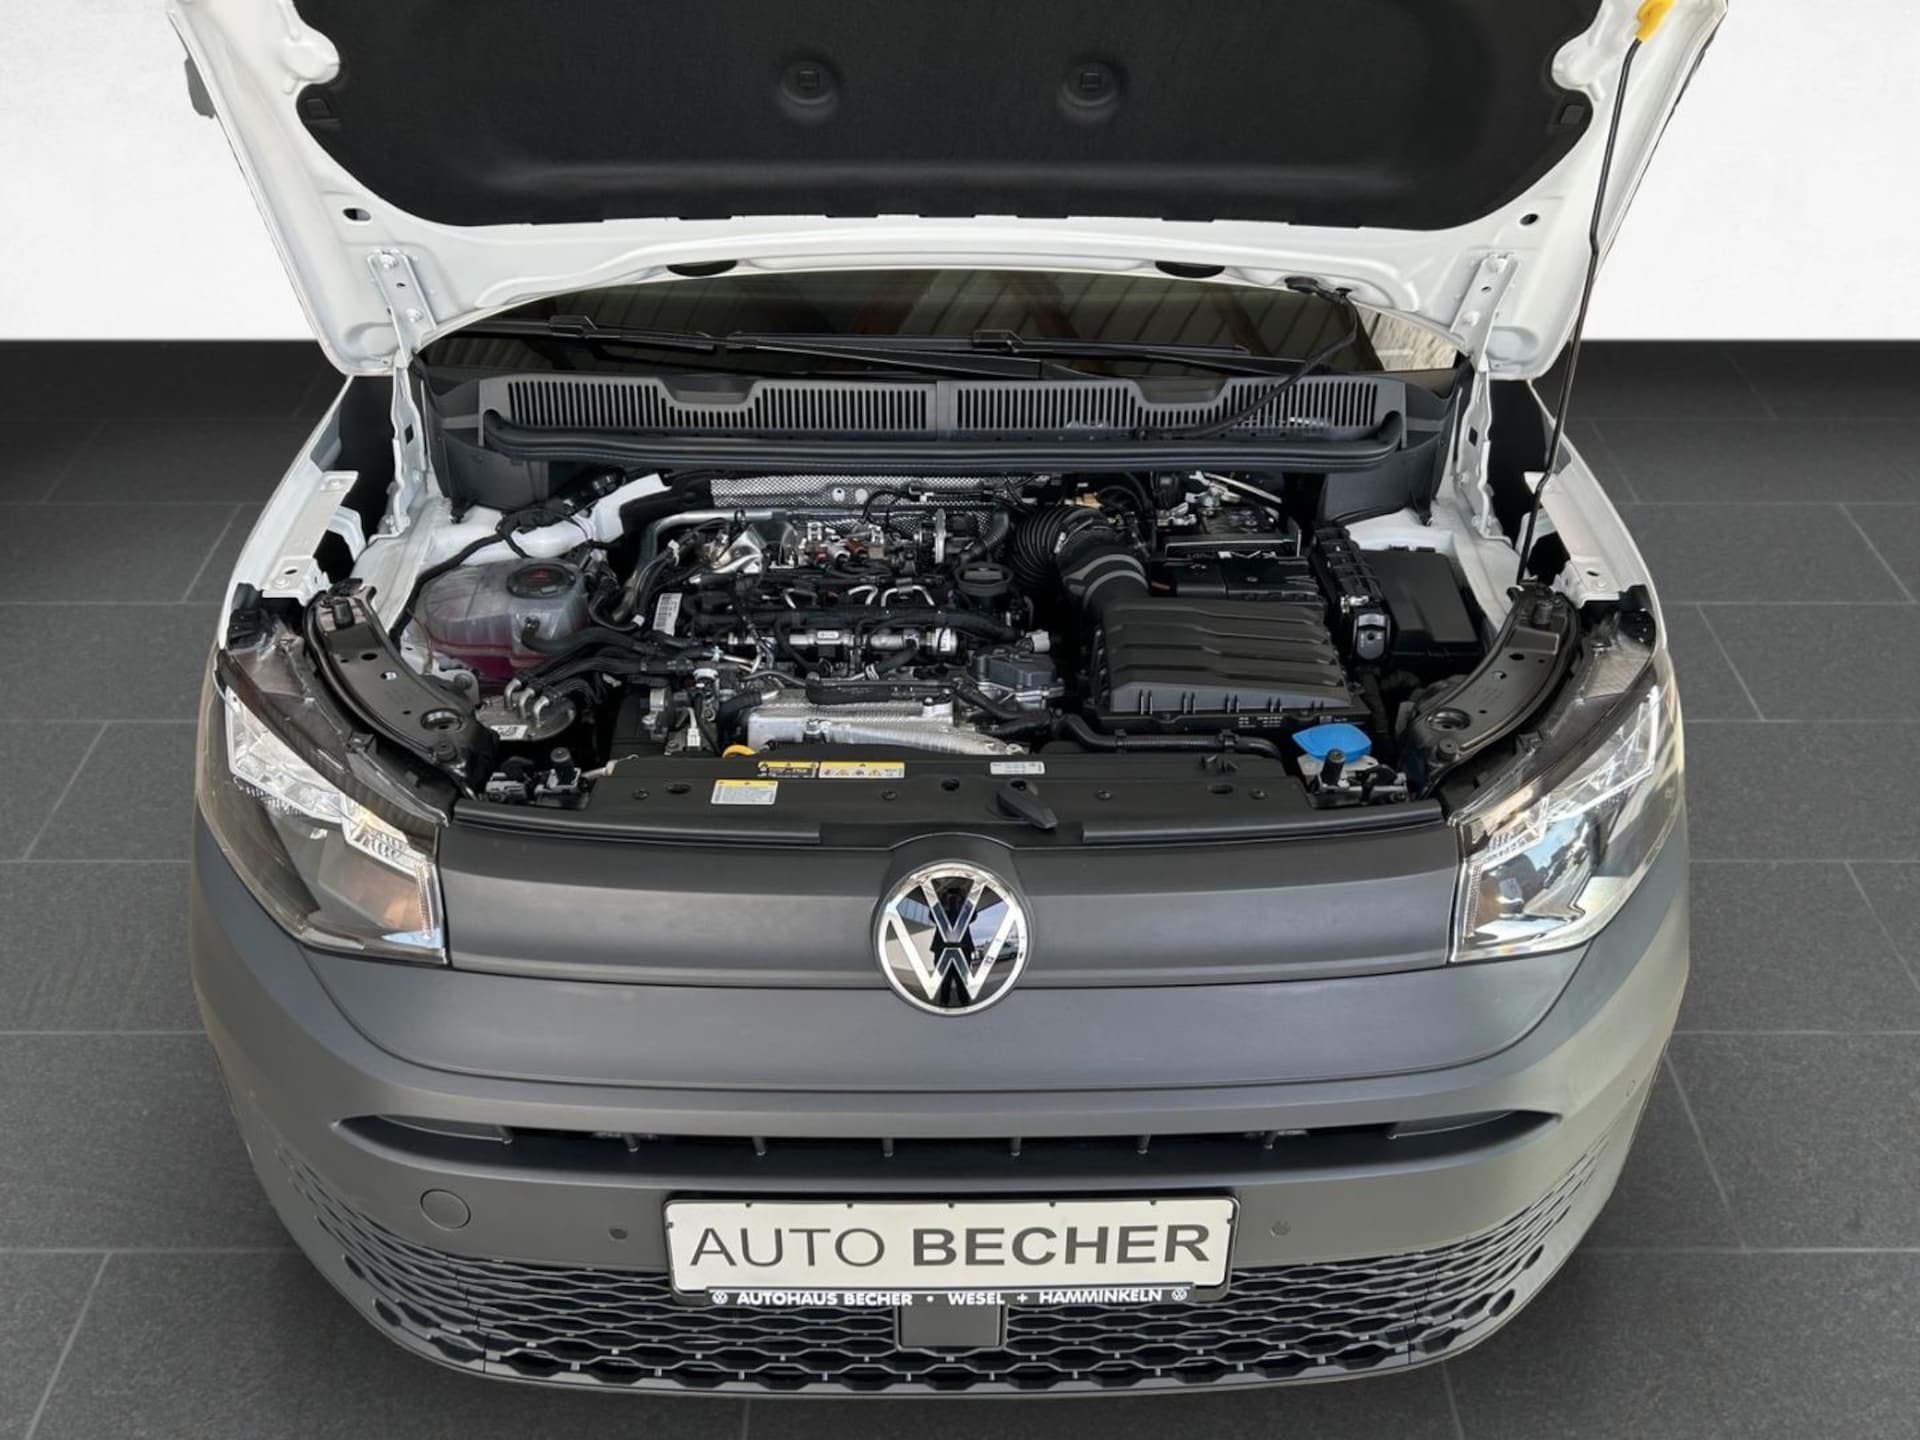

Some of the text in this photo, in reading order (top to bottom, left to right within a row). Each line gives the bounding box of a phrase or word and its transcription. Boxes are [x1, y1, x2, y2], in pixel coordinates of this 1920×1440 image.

[878, 863, 1028, 1016] VW
[689, 1224, 1210, 1267] AUTO BECHER
[736, 1291, 838, 1306] AUTOHAUS
[843, 1291, 913, 1306] BECHER
[948, 1291, 1006, 1306] WESEL
[1039, 1288, 1163, 1304] HAMMINKELN
